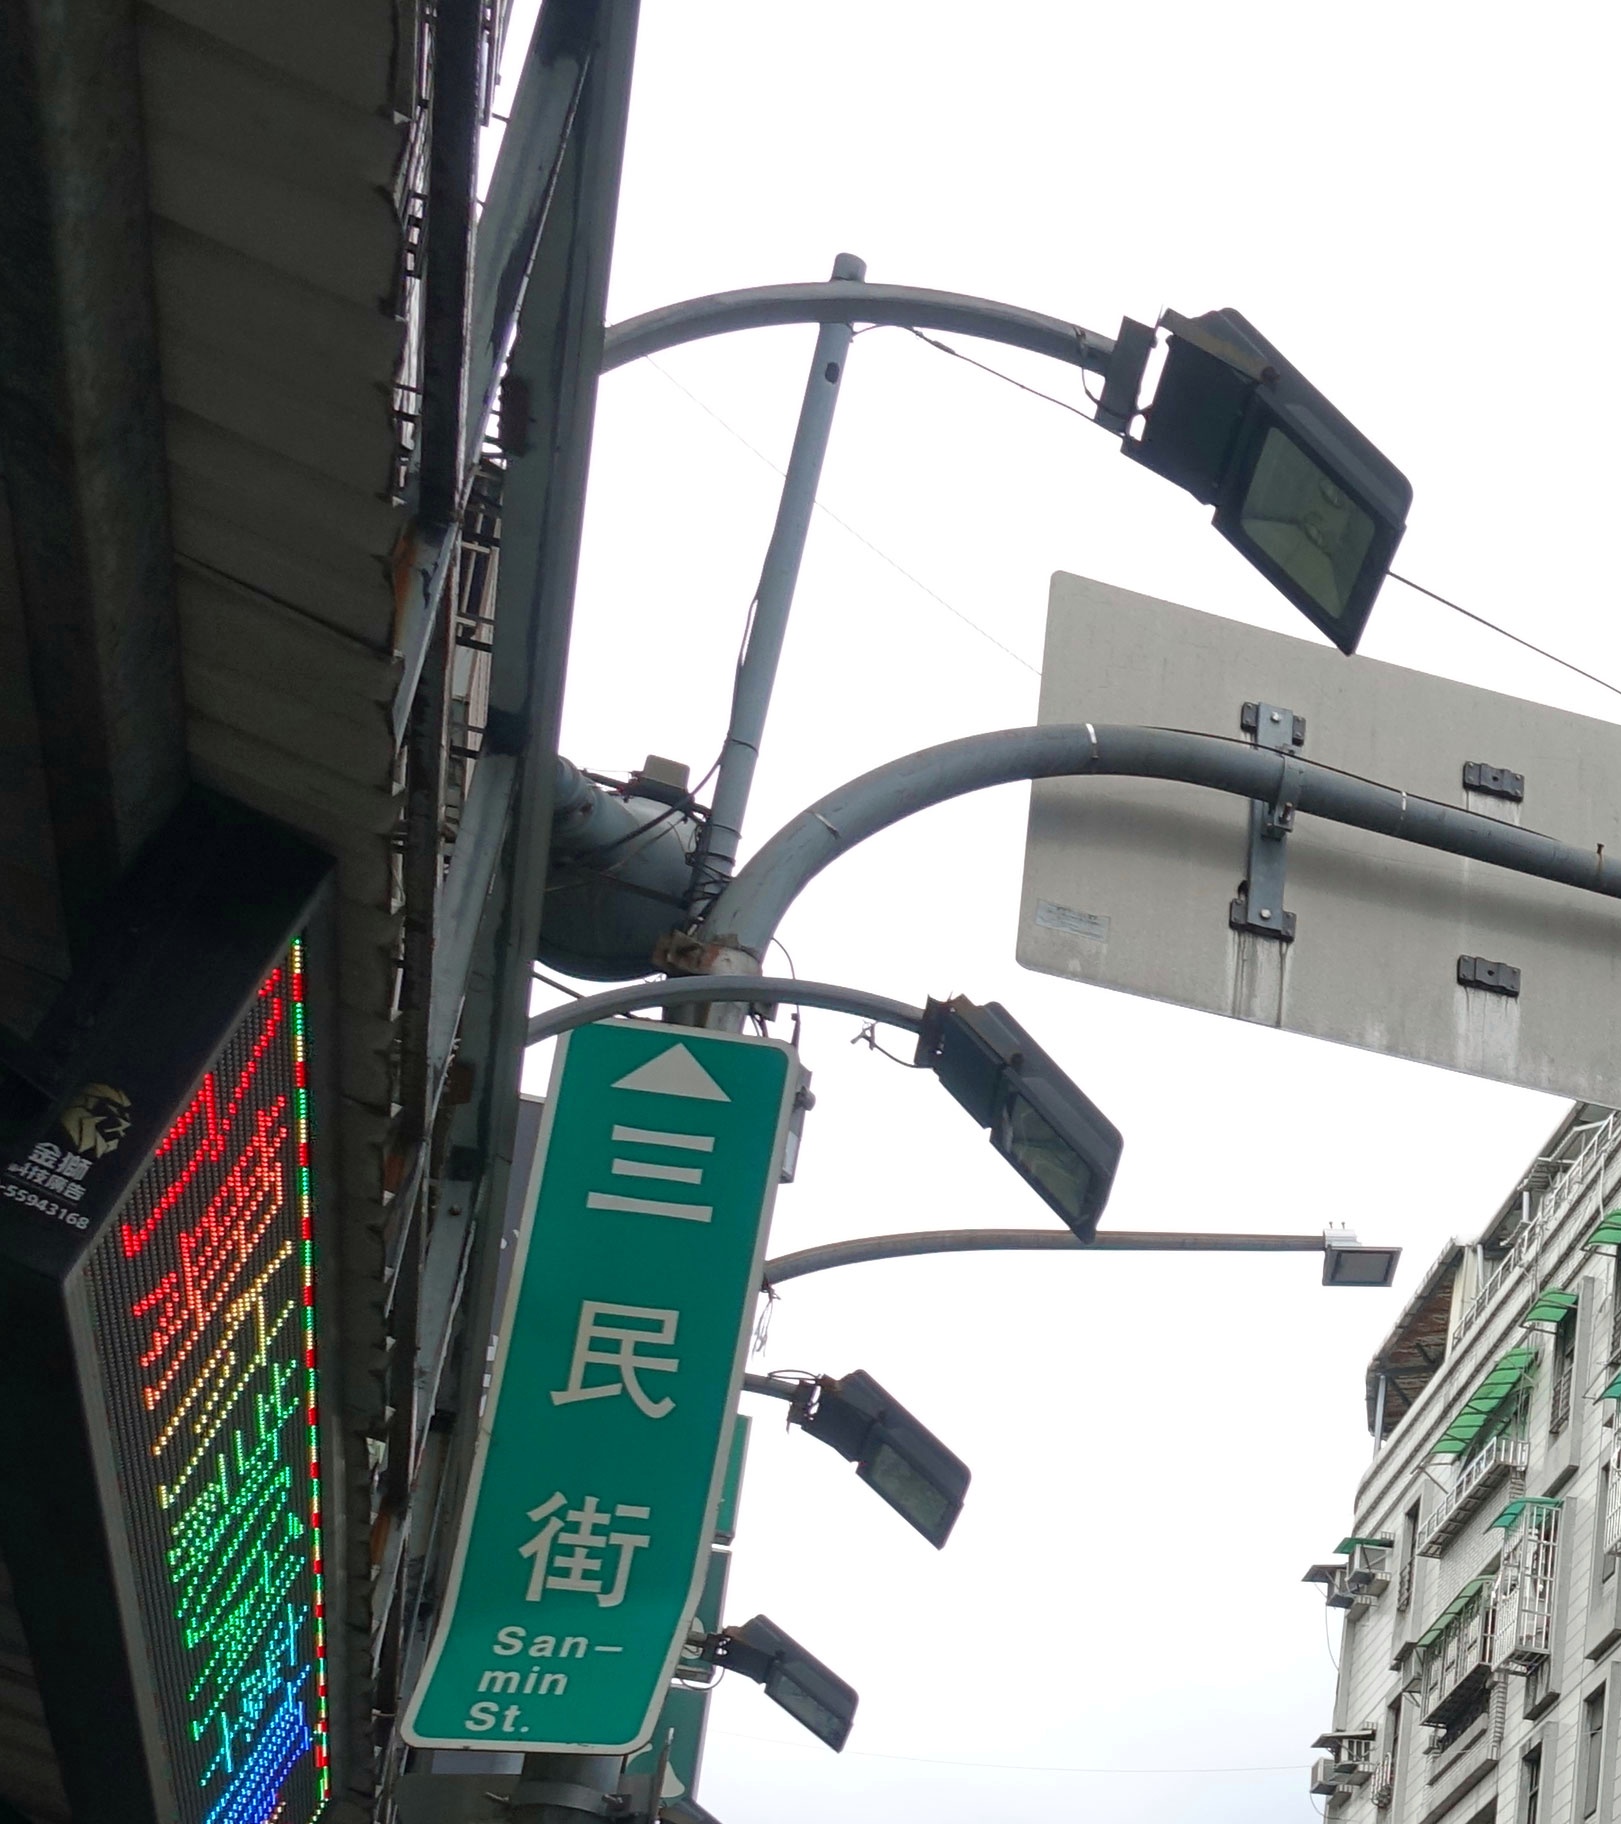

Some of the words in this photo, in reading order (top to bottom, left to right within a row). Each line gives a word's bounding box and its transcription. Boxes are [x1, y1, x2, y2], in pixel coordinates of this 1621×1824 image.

[28, 1141, 93, 1181] 金獅
[519, 1123, 716, 1608] 三民街
[493, 1625, 622, 1659] San-
[478, 1667, 567, 1695] min
[467, 1700, 531, 1733] St.
